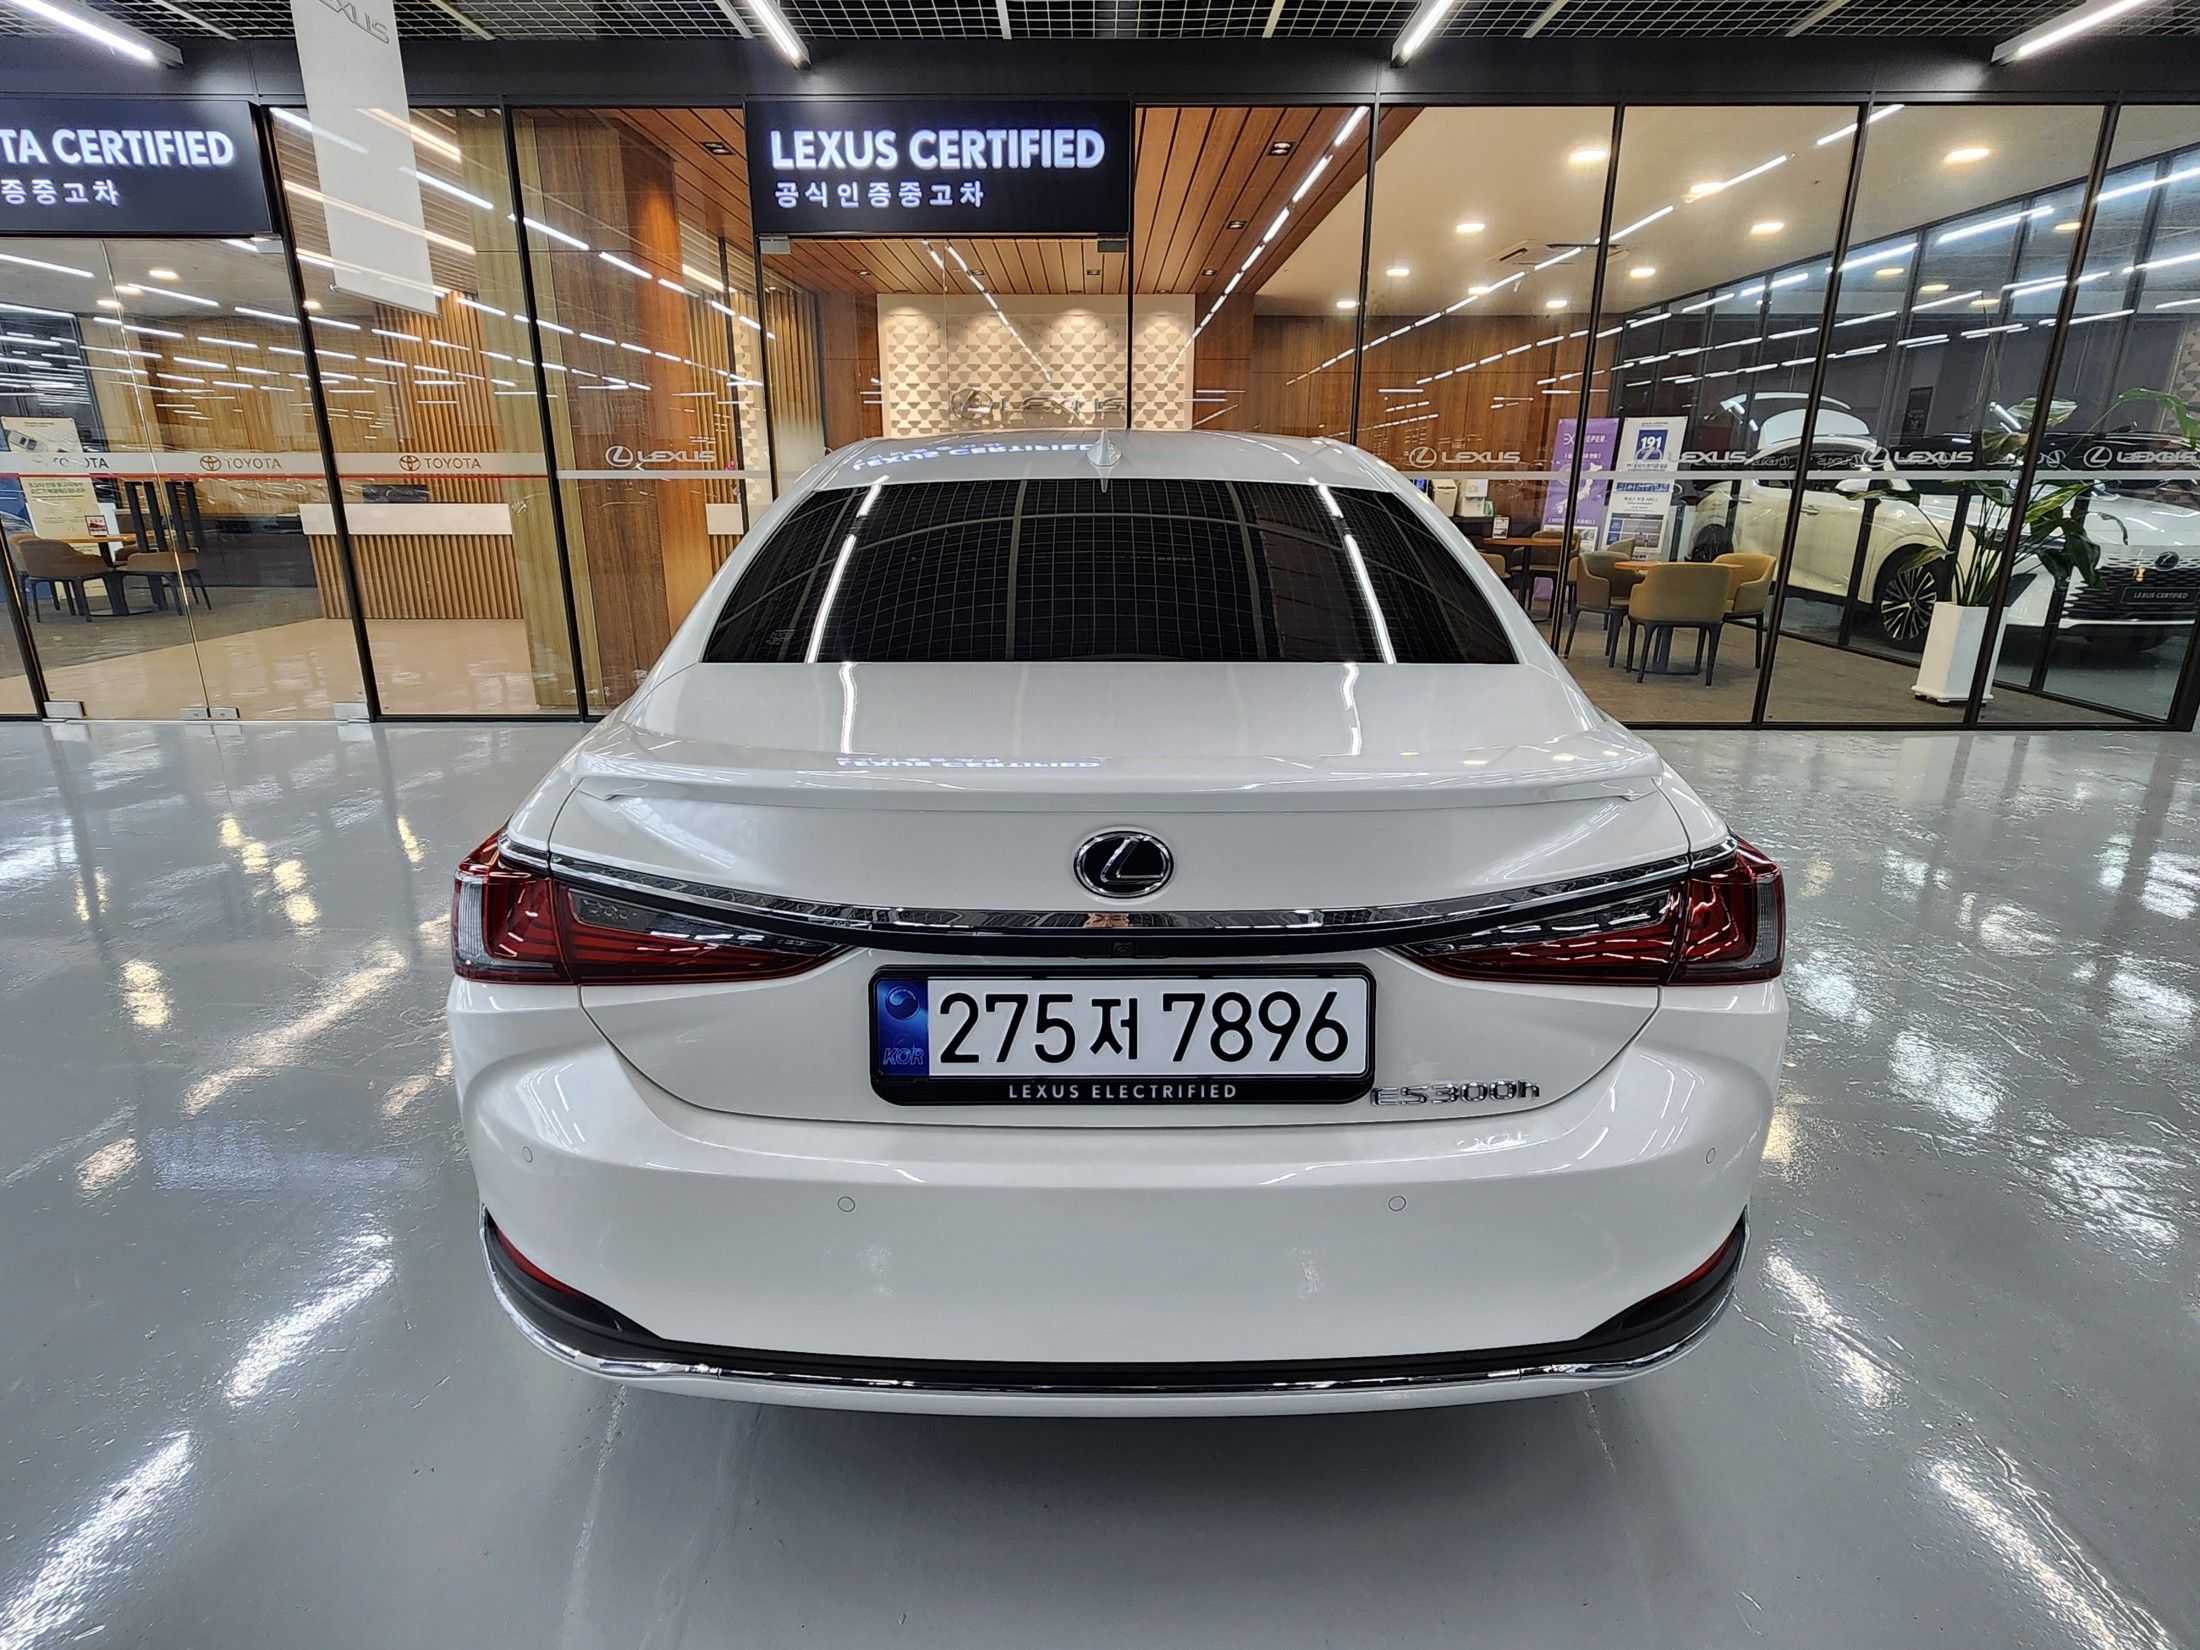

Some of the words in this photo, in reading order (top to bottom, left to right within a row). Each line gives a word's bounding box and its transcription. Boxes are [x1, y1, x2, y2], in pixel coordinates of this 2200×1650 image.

[52, 129, 235, 167] CERTIFIED
[770, 130, 898, 169] LEXUS
[908, 129, 1106, 169] CERTIFIED
[1641, 436, 1662, 449] 191
[637, 450, 716, 462] LEXUS
[1441, 451, 1521, 463] LEXUS
[1894, 451, 1974, 463] LEXUS
[223, 458, 282, 469] TOYOTA
[423, 458, 482, 469] TOYOTA
[939, 992, 1138, 1064] 275저
[1162, 991, 1349, 1063] 7896
[883, 1047, 924, 1065] KOR
[1008, 1084, 1080, 1099] LEXUS
[1091, 1084, 1237, 1099] ELECTRIFIED
[1369, 1080, 1541, 1107] ES300h
